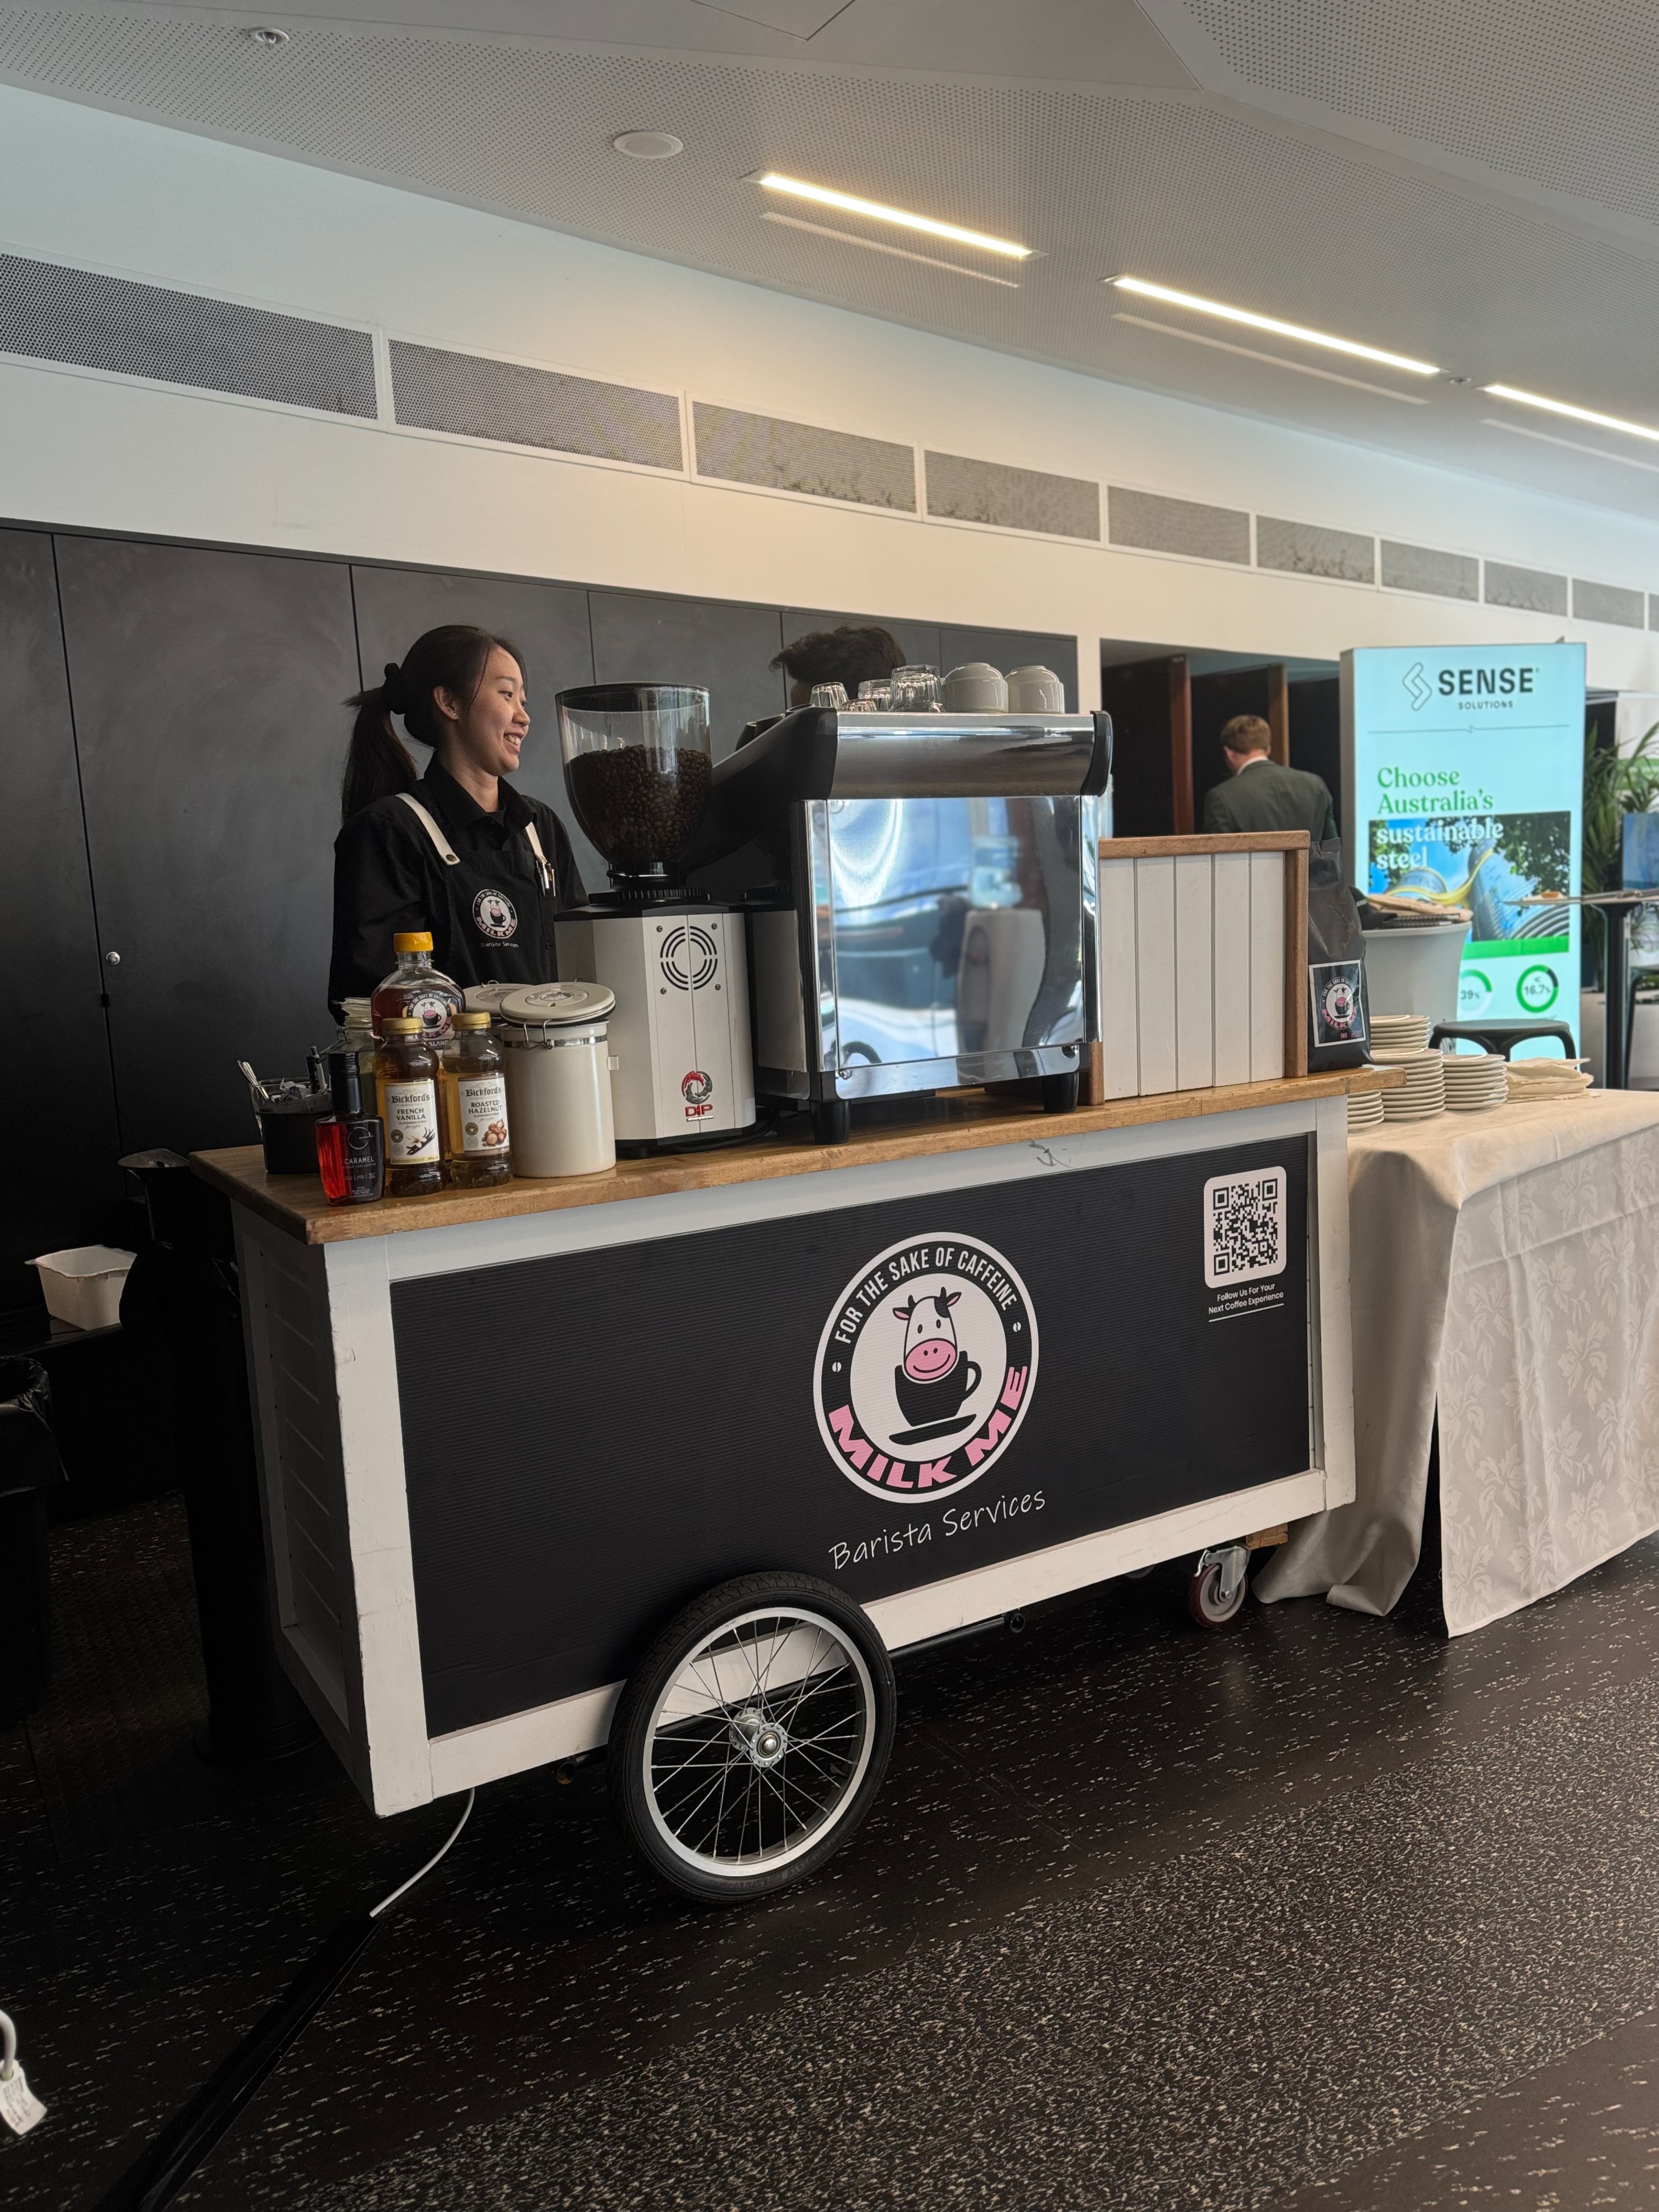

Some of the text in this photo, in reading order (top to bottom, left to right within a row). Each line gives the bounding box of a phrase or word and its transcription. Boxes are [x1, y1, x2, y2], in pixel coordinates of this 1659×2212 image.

[1438, 668, 1533, 696] SENSE
[1458, 700, 1514, 710] SOLUTIONS
[1377, 766, 1460, 788] Choose
[1377, 788, 1493, 814] Australia's
[1376, 816, 1504, 844] sustainable
[1376, 845, 1427, 870] steel
[476, 916, 516, 936] MILK ME
[1524, 985, 1551, 995] 16.7%
[1322, 1008, 1347, 1028] MILK
[391, 1093, 430, 1104] Bickford's
[465, 1086, 501, 1097] Bickford's
[469, 1105, 503, 1114] HAZELNUT
[685, 1104, 713, 1117] DIP
[345, 1156, 375, 1165] CARAMEL
[834, 1247, 1017, 1344] FOR THE SAKE OF CAFFEINE
[1217, 1291, 1239, 1302] Follow
[1239, 1289, 1248, 1297] Us
[1260, 1283, 1276, 1292] Your
[1209, 1292, 1284, 1314] Next Coffee Experience
[828, 1365, 1028, 1488] MILK ME
[828, 1491, 1046, 1570] Barista Services
